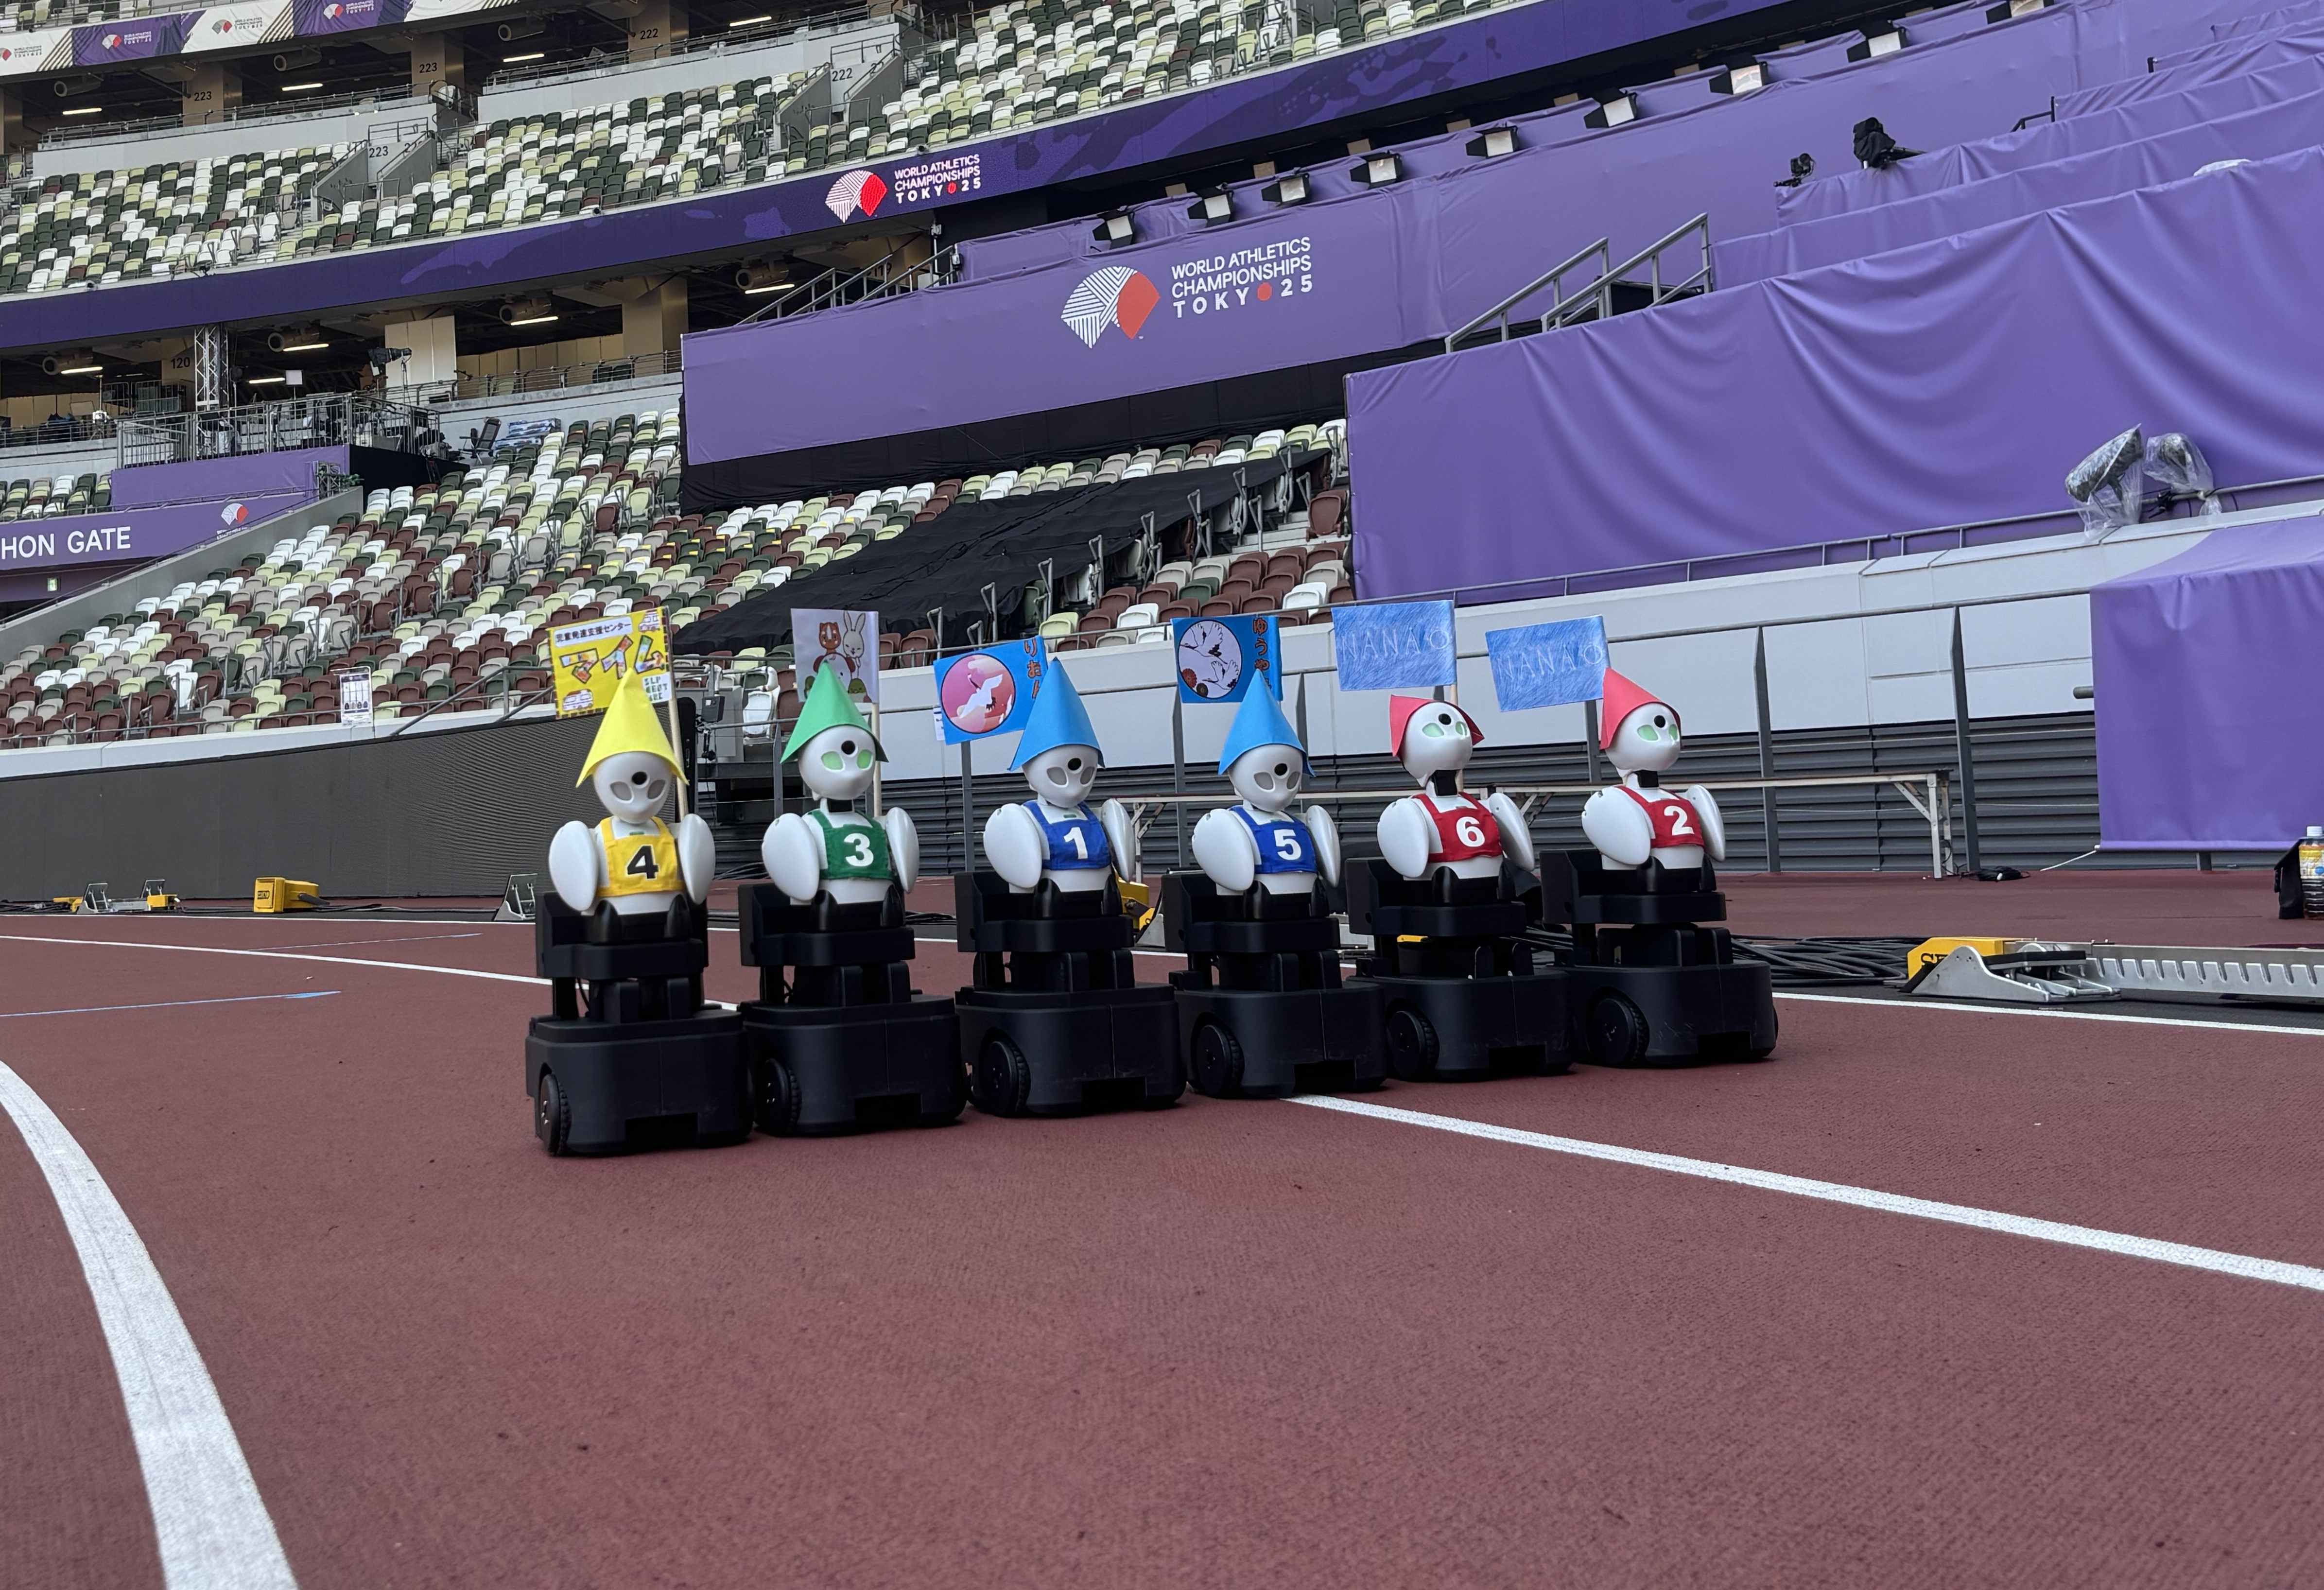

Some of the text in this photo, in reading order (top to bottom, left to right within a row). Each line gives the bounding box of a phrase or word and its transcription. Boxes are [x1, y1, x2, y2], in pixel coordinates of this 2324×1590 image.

[640, 28, 659, 40] 222
[419, 62, 438, 73] 223
[832, 68, 853, 82] 222
[194, 91, 212, 101] 223
[369, 146, 388, 158] 223
[894, 154, 980, 180] WORLD ATHLETICS
[894, 165, 981, 191] CHAMPIONSHIPS
[1171, 236, 1311, 280] WORLD ATHLETICS
[1172, 254, 1312, 298] CHAMPIONSHIPS
[171, 356, 191, 370] 120
[1, 526, 131, 560] HON GATE
[559, 634, 665, 685] マイム
[1456, 816, 1486, 847] 6
[1663, 805, 1695, 836] 2
[843, 833, 875, 867] 3
[1063, 827, 1089, 860] 1
[1273, 829, 1302, 861] 5
[625, 844, 660, 880] 4
